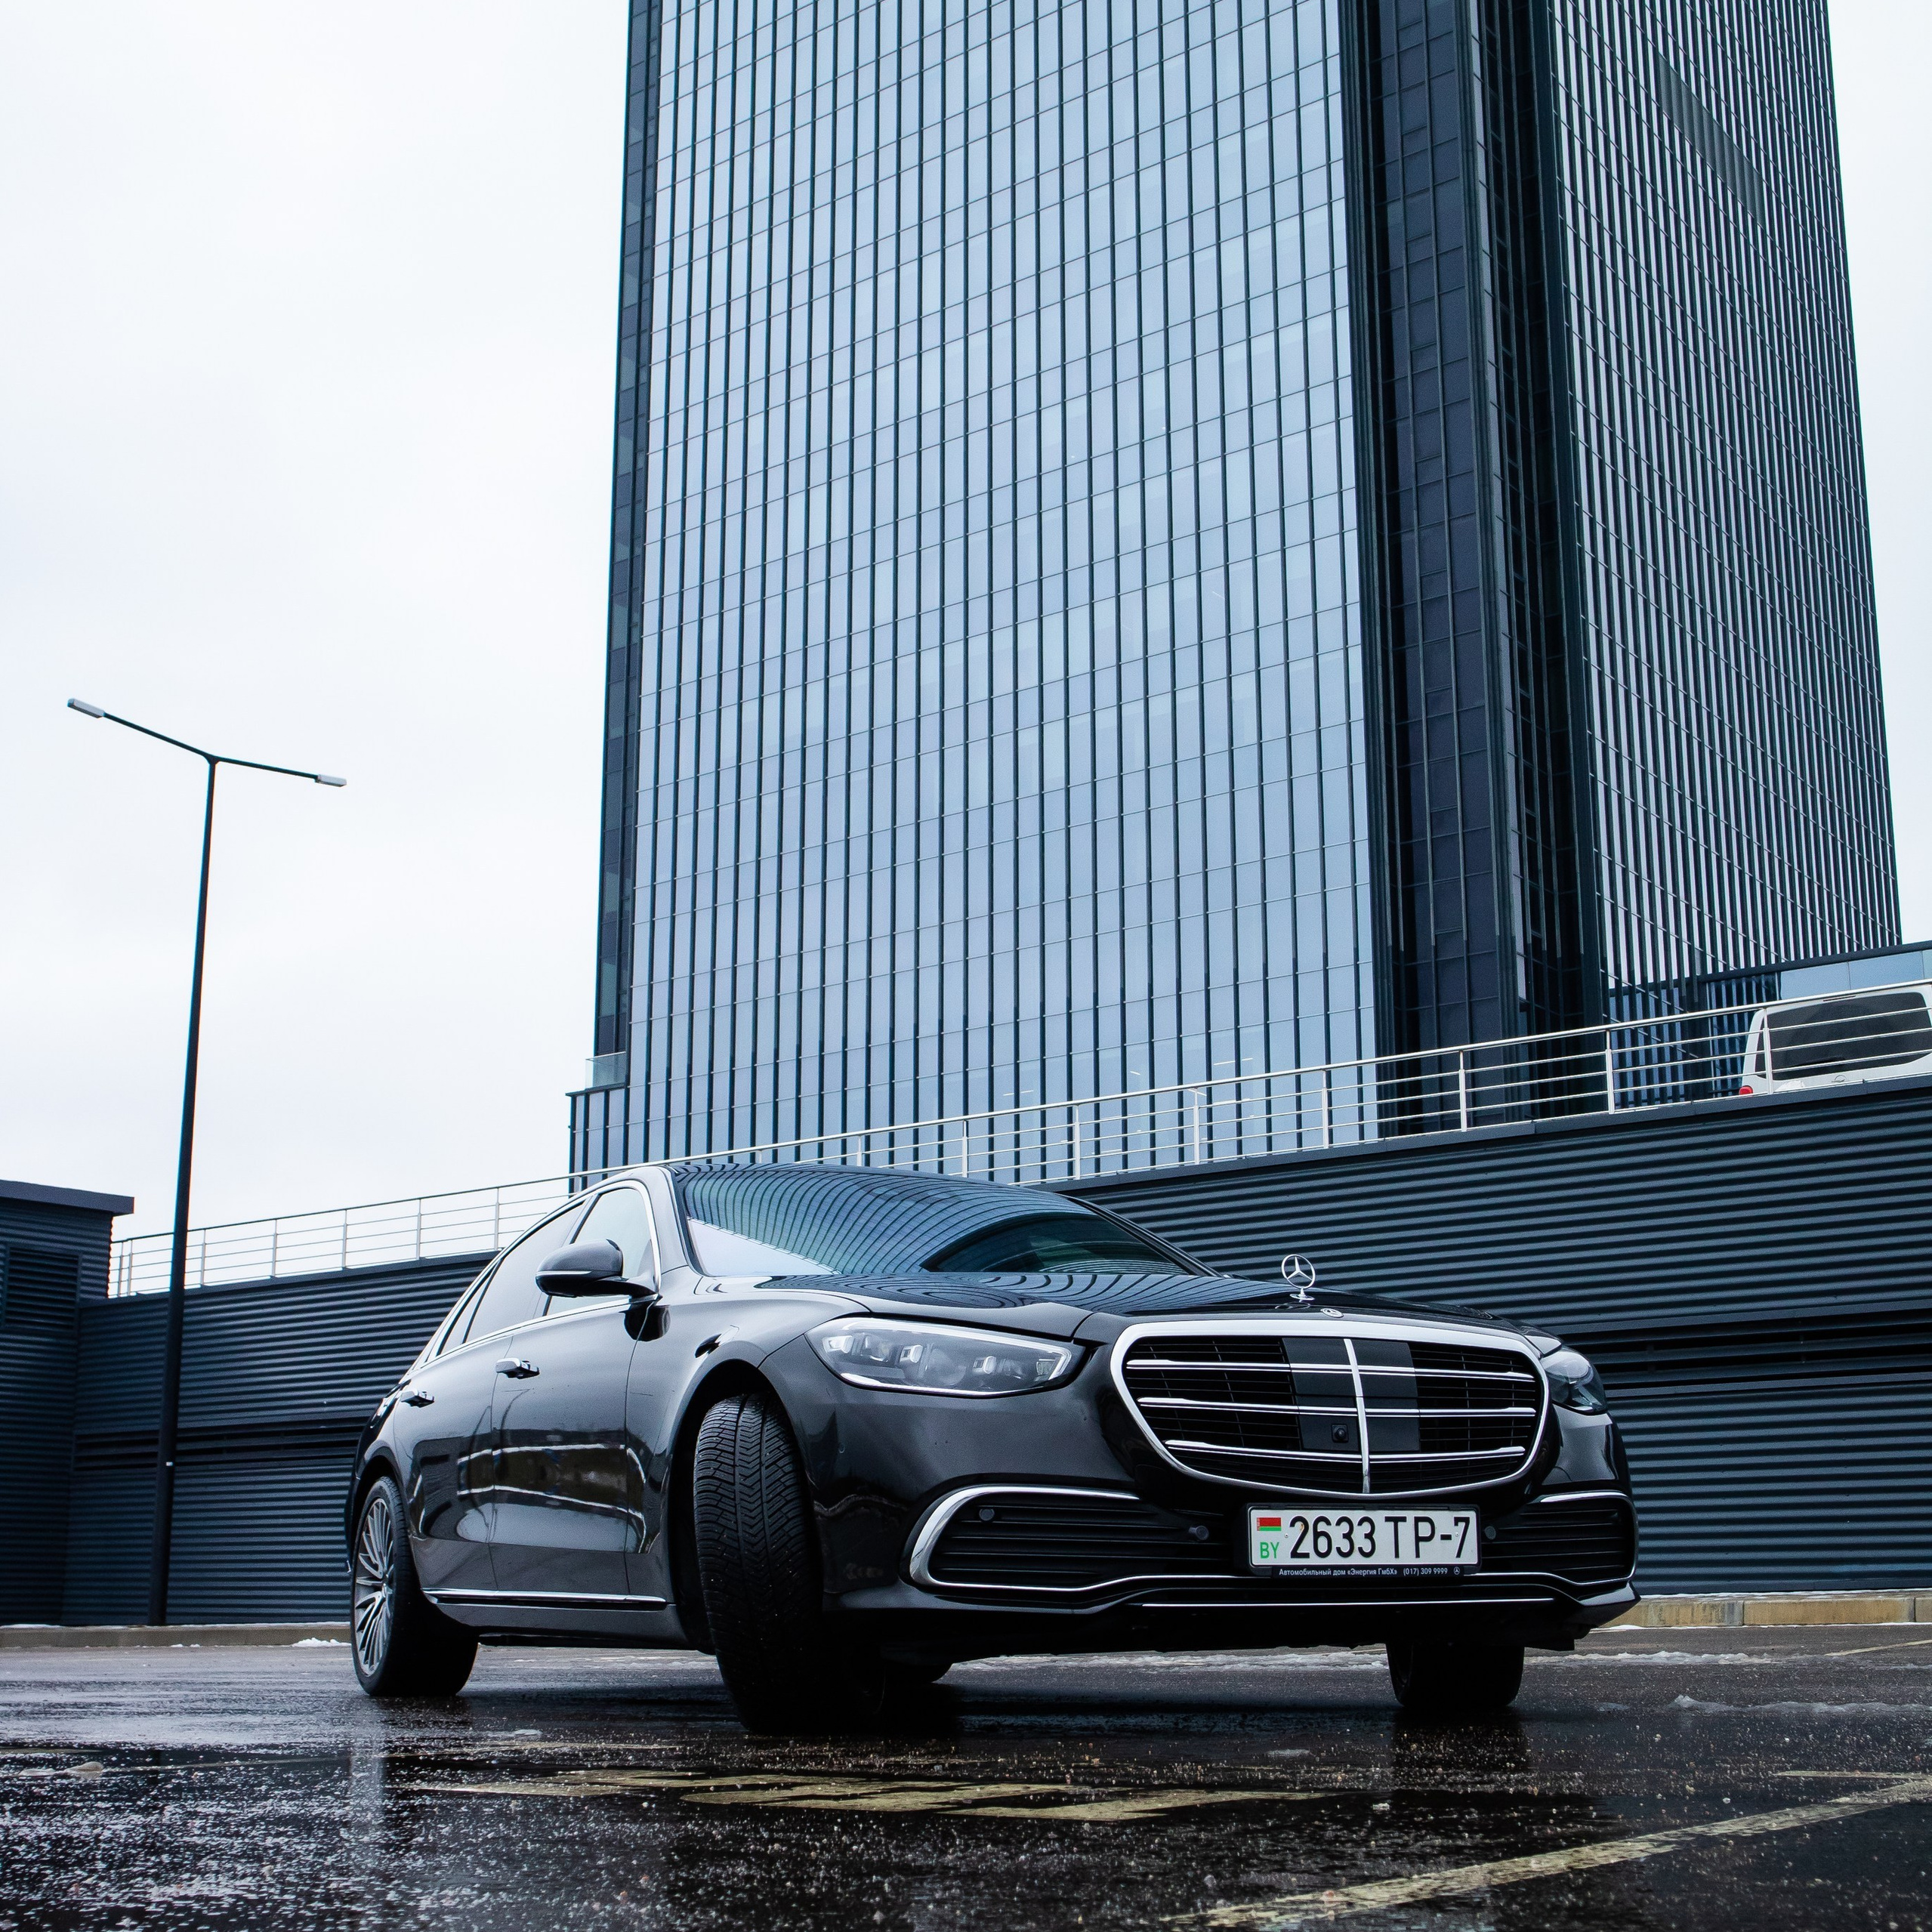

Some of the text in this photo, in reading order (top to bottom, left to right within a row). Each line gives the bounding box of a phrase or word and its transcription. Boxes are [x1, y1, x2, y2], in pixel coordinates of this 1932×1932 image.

[1289, 1516, 1376, 1558] 2633
[1260, 1542, 1279, 1559] BY
[1347, 1568, 1377, 1576] «Энергия
[1403, 1567, 1419, 1576] (017)
